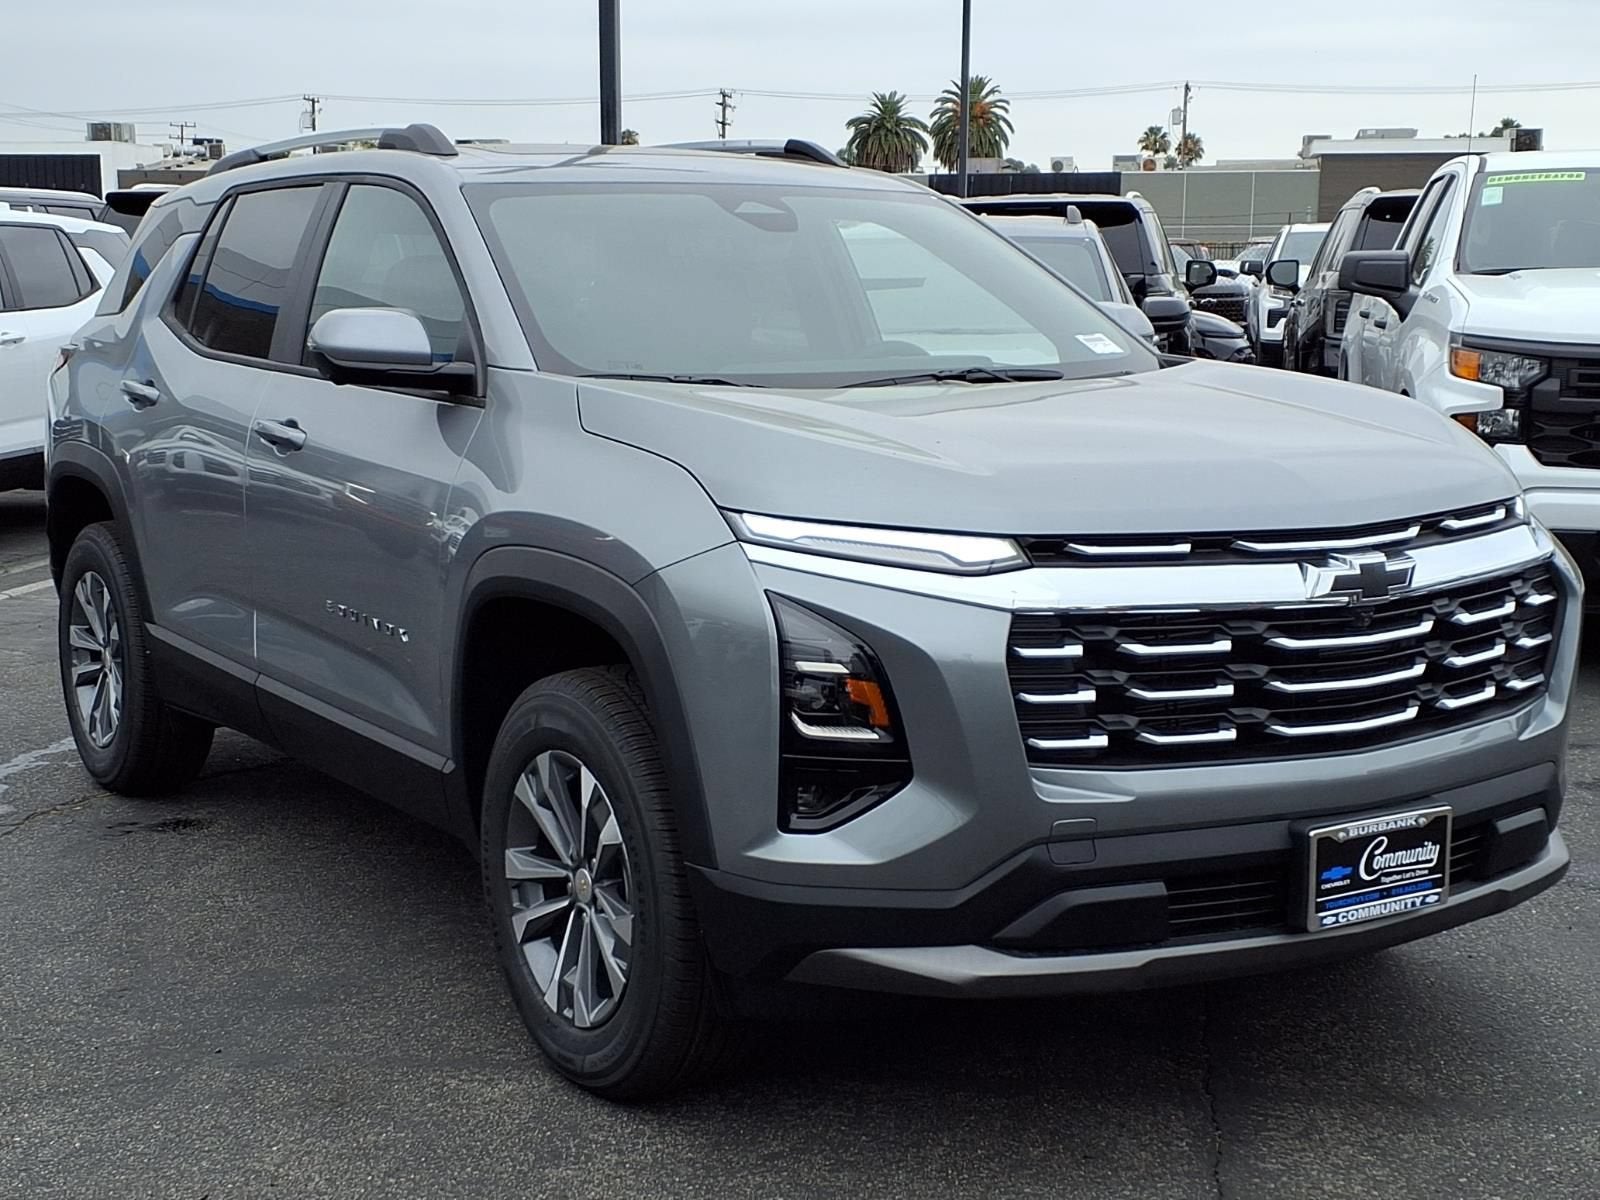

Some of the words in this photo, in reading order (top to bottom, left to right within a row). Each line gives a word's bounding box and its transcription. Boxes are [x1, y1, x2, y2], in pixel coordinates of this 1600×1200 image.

[1349, 818, 1416, 836] BURBANK
[1359, 836, 1440, 880] Community
[1321, 879, 1350, 889] CHEVROLET
[1338, 896, 1423, 922] COMMUNITY
